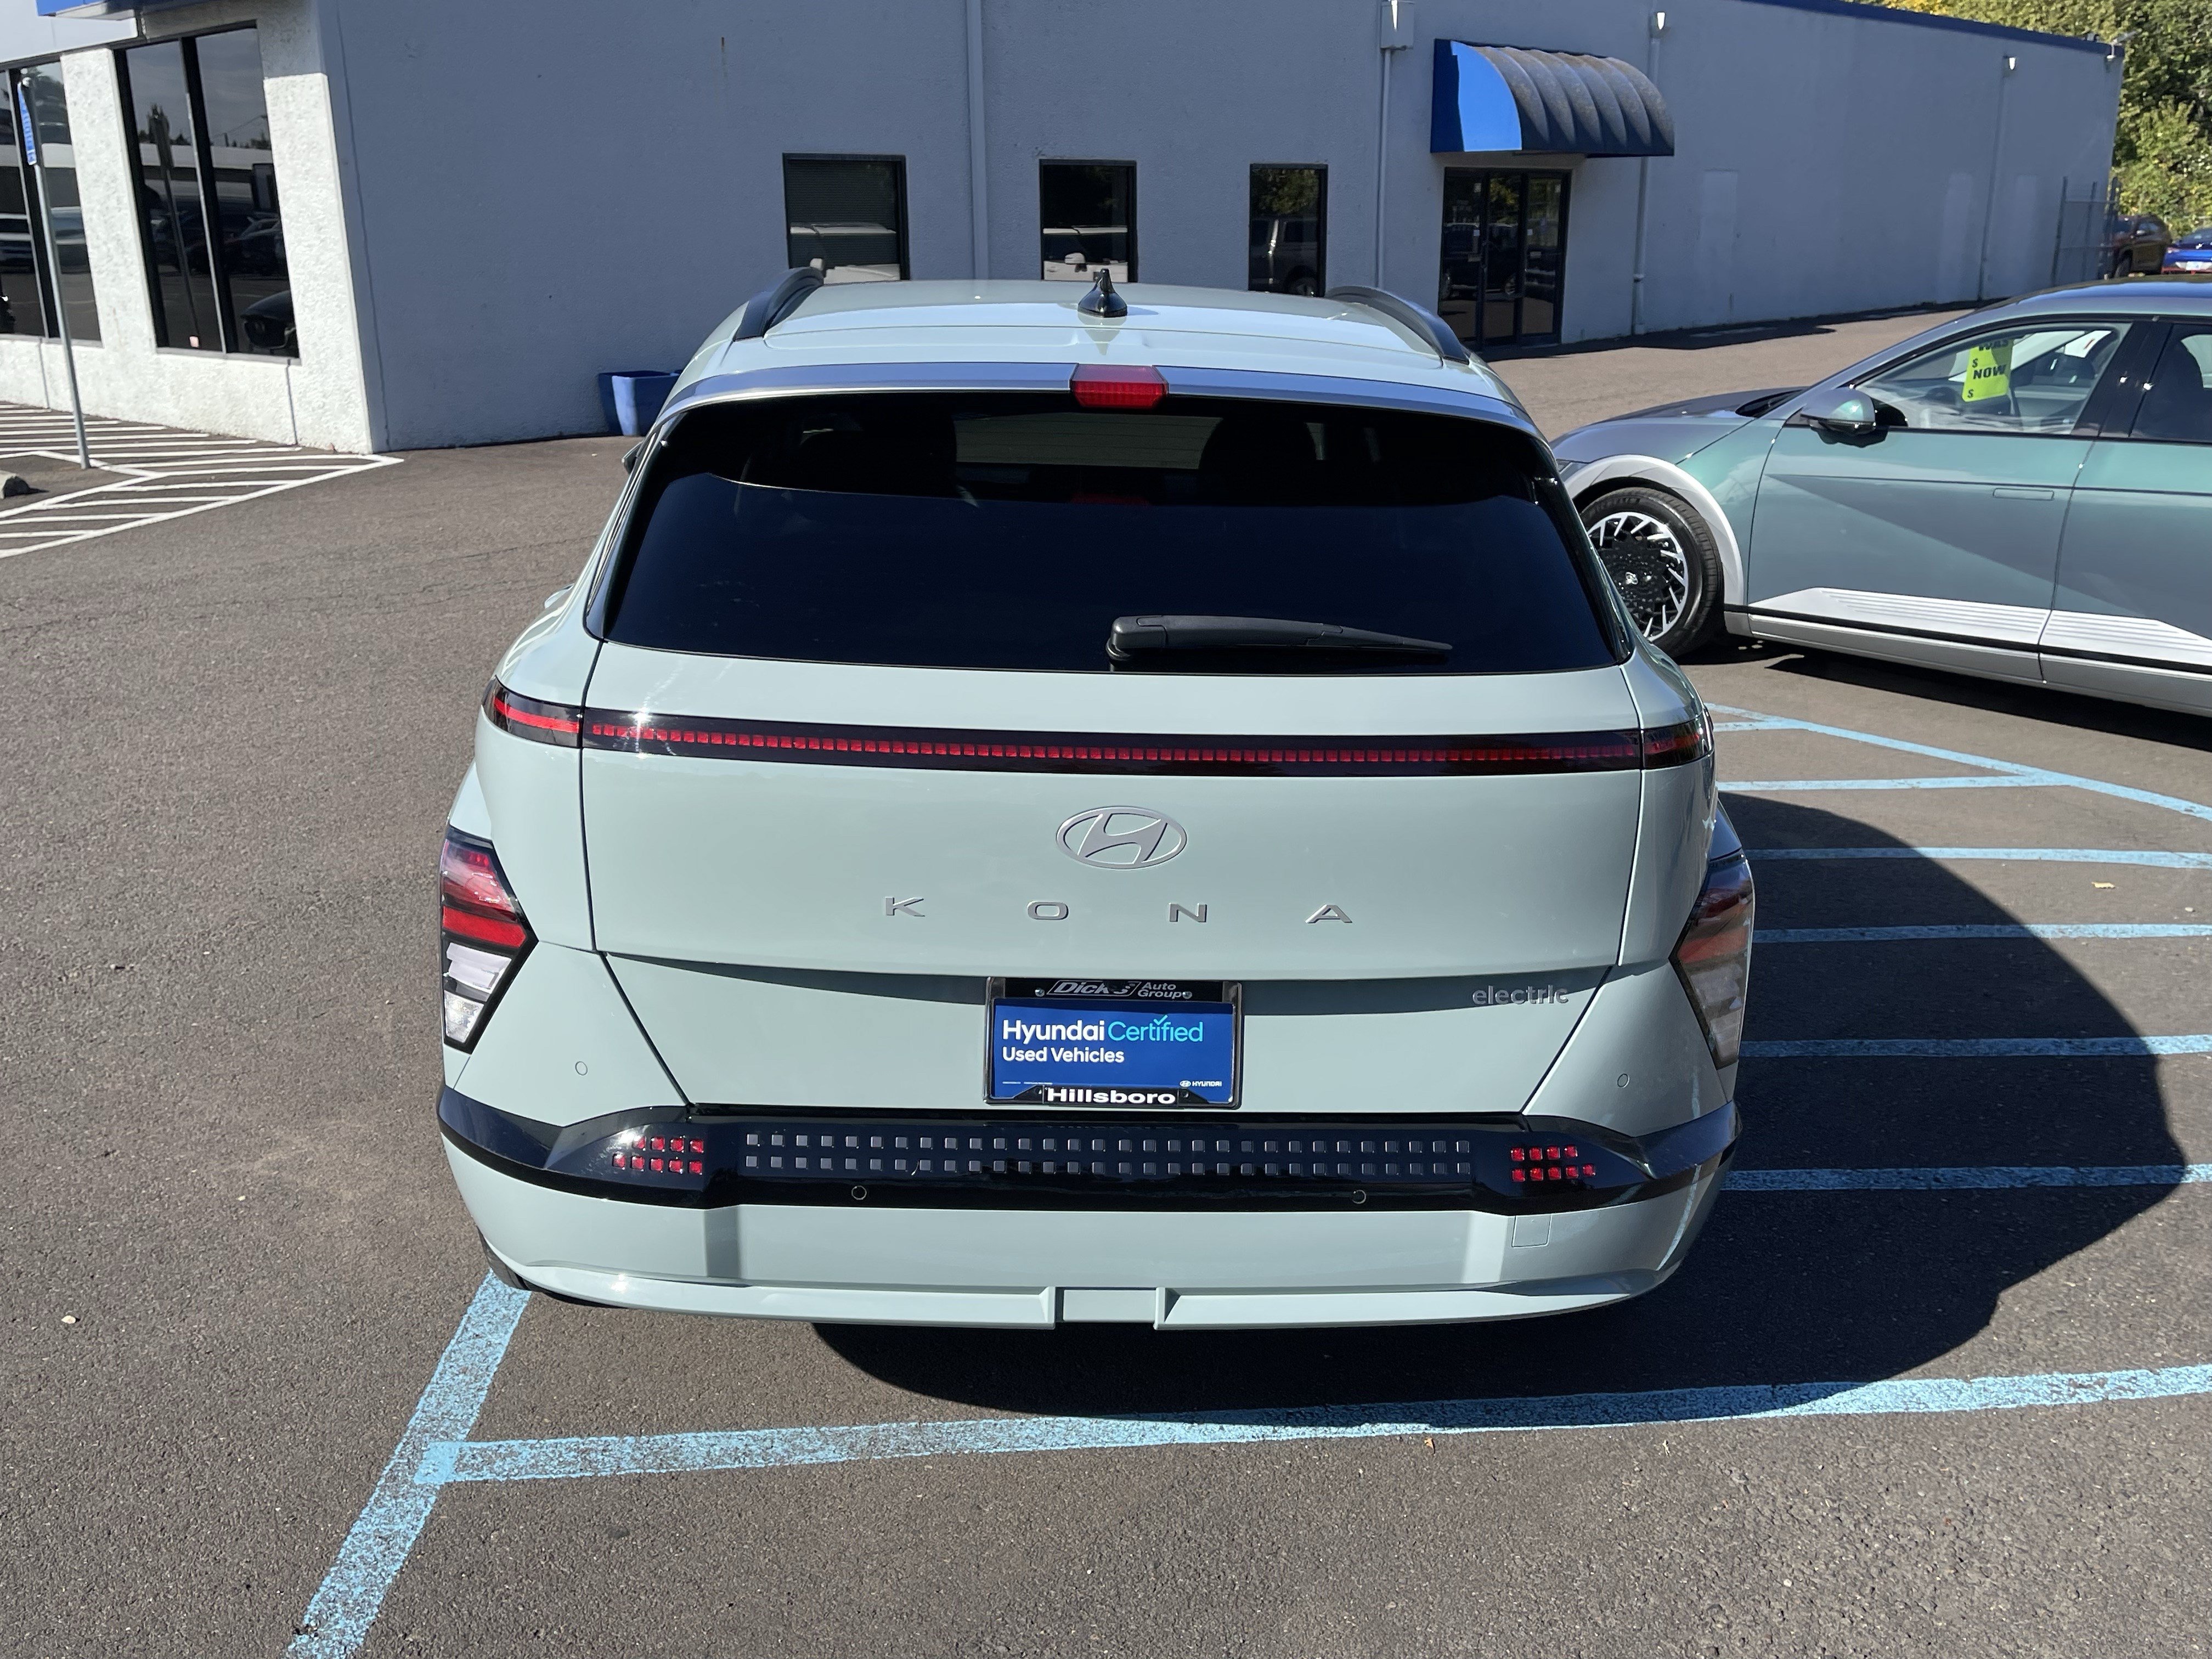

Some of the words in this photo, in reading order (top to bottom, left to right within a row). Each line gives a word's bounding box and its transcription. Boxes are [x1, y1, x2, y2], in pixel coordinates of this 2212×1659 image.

[1973, 364, 2006, 379] NOW
[1142, 982, 1176, 991] Auto
[1472, 985, 1569, 1005] electric
[1002, 1020, 1105, 1044] Hyundai
[1108, 1015, 1203, 1042] Certified
[1002, 1047, 1047, 1062] Used
[1051, 1047, 1125, 1063] Vehicles
[1047, 1087, 1176, 1104] Hillsboro
